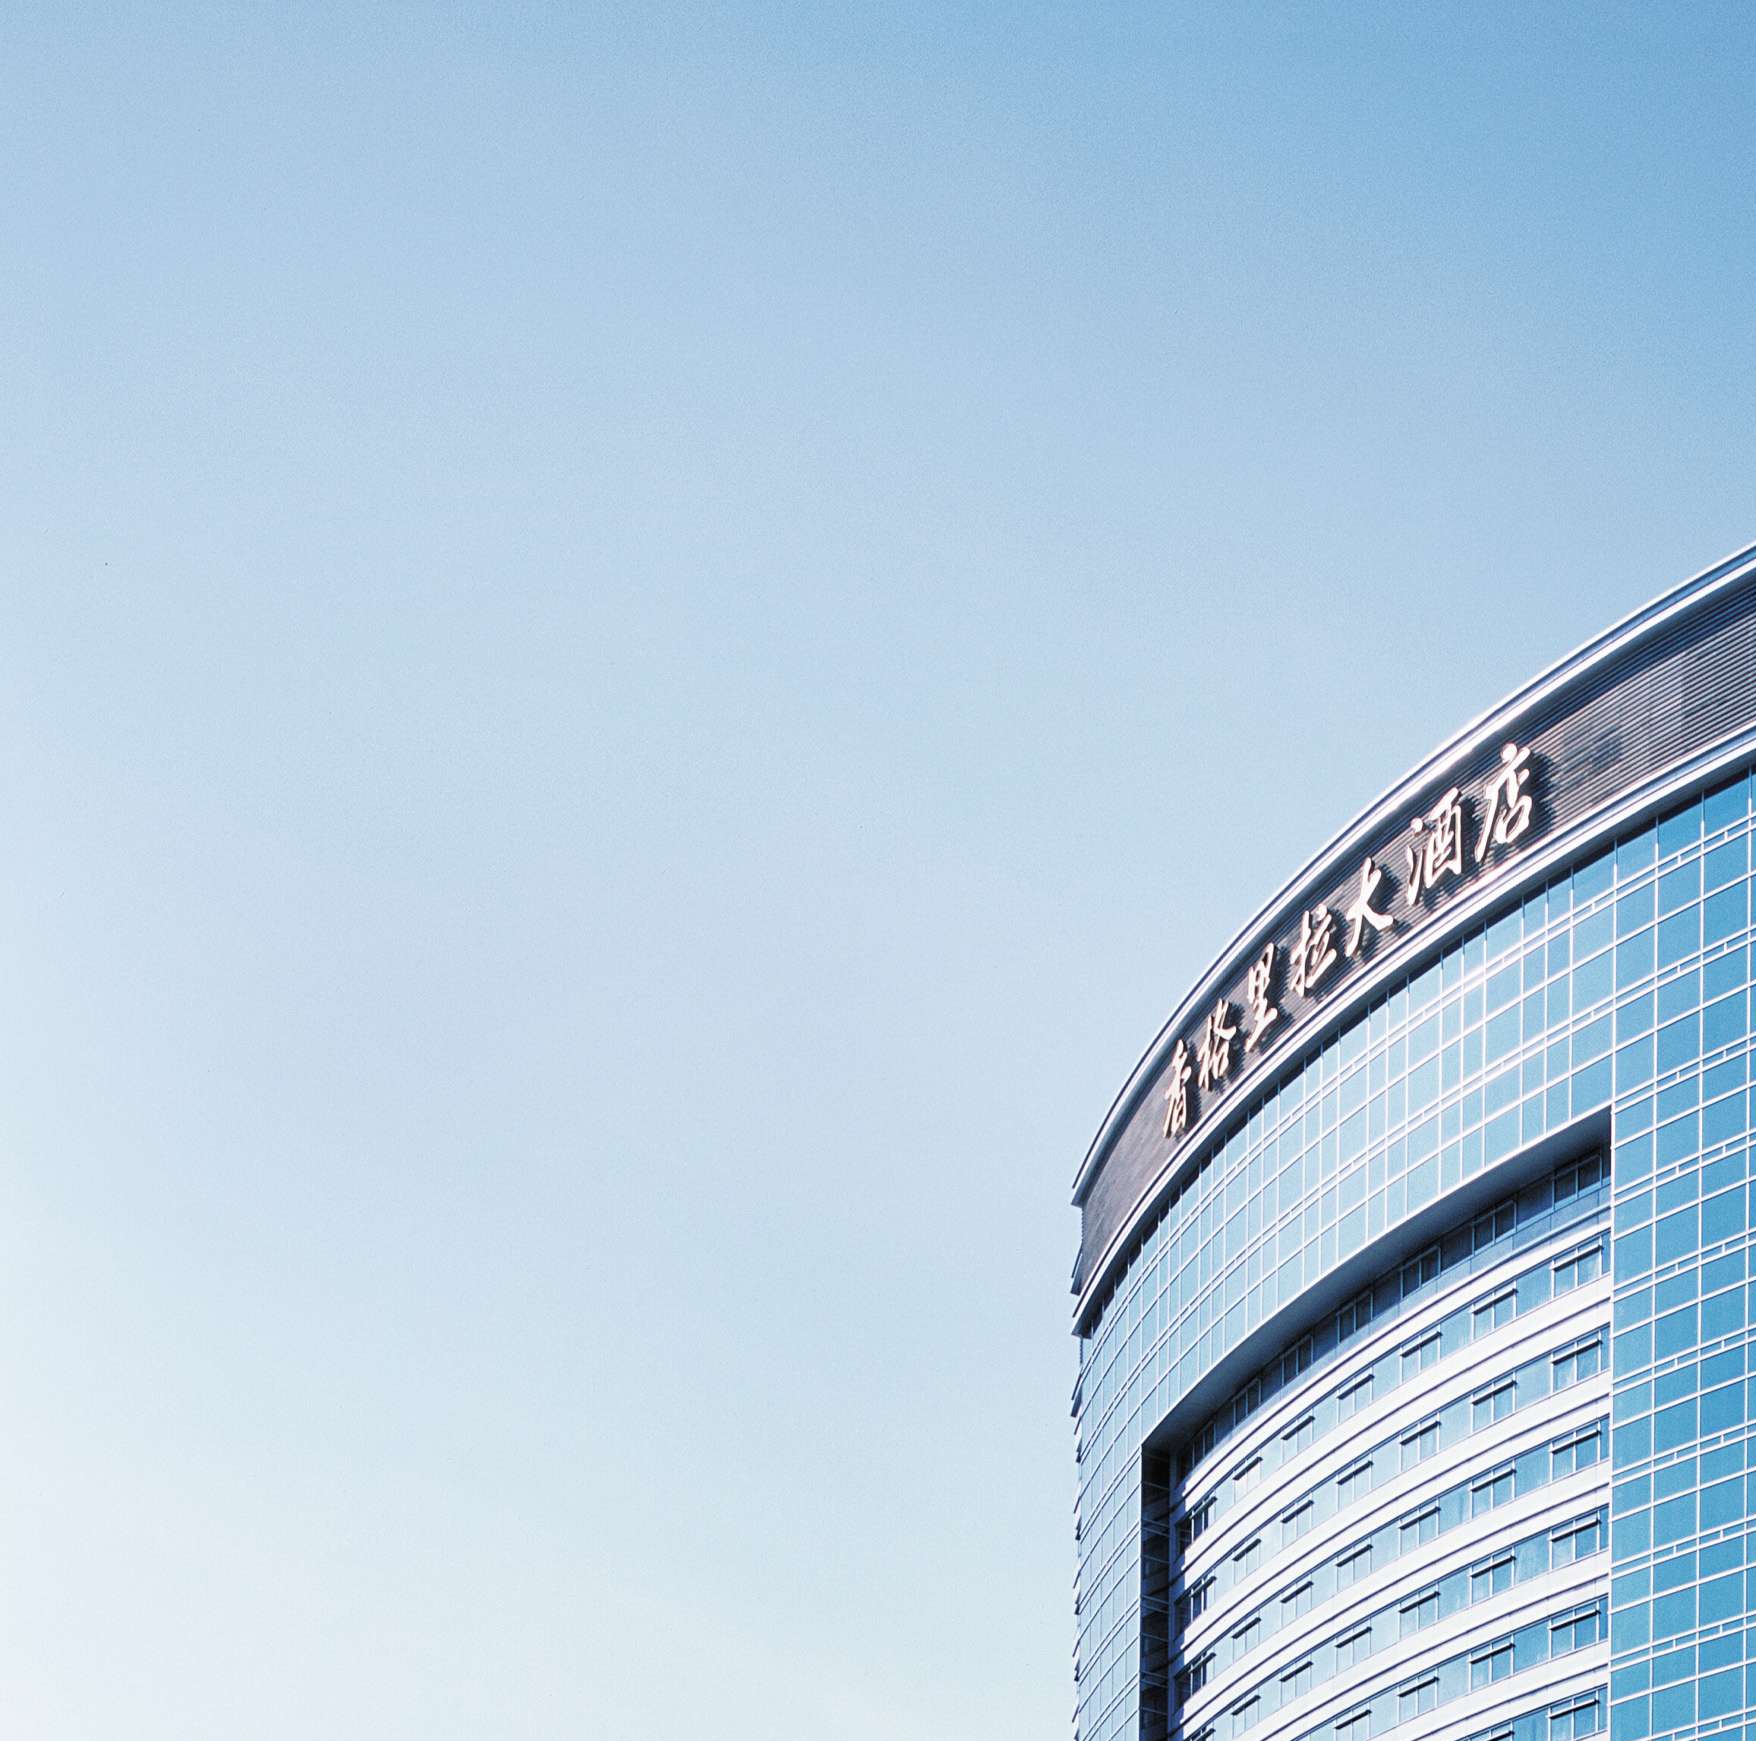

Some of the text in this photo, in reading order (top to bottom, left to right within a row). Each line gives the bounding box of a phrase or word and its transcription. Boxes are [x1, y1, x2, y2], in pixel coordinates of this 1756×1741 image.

[1162, 743, 1533, 1139] 香格里拉大酒店
